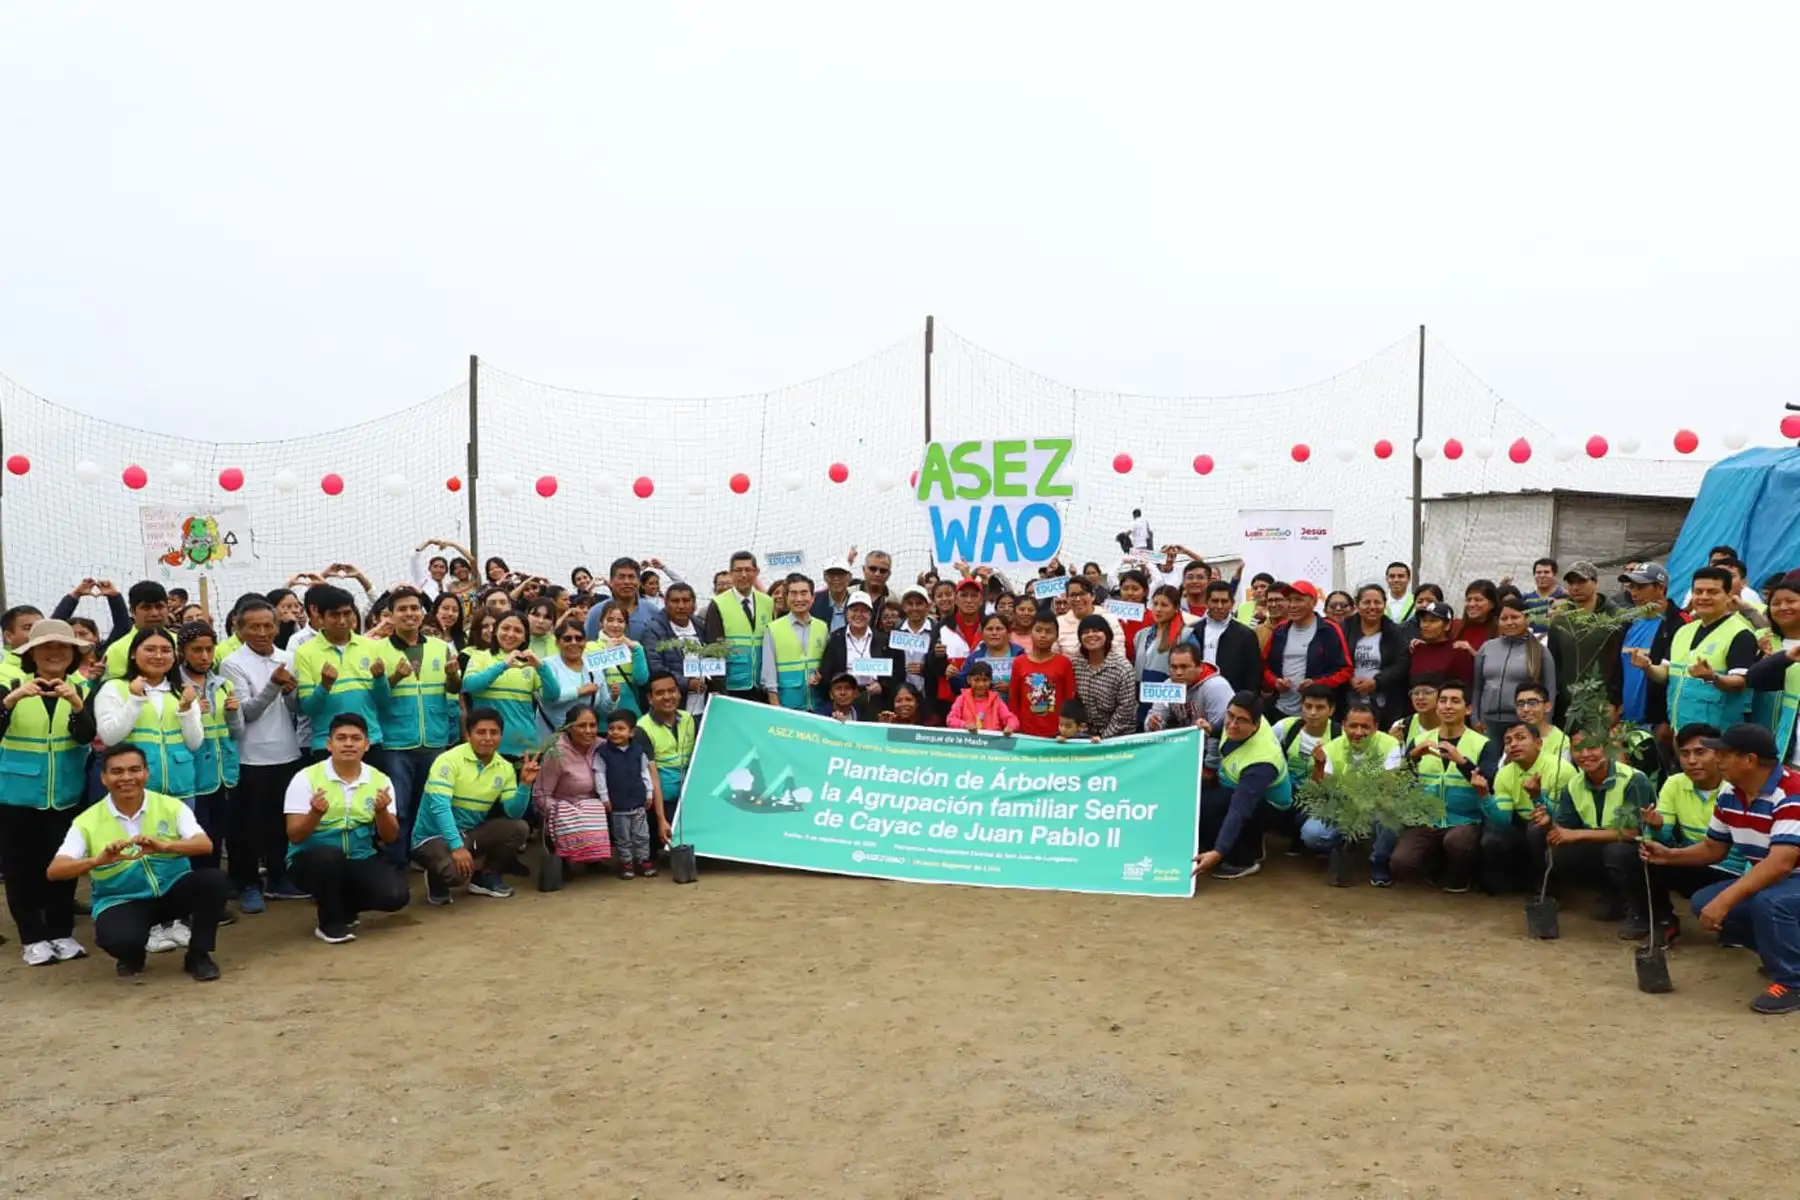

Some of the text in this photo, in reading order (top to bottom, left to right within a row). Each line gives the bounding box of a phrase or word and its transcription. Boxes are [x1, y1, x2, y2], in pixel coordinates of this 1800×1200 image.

[917, 439, 1074, 501] ASEZ
[929, 503, 1062, 563] WAO
[1036, 580, 1066, 595] EDUCC
[588, 651, 625, 667] EDUCCA
[892, 634, 925, 648] EDUCCA
[1143, 687, 1181, 698] EDUCCA
[828, 756, 1117, 792] Plantación de Árboles en
[820, 782, 1159, 820] la Agrupación familiar Señor
[814, 808, 1121, 848] de Cayac de Juan Pablo II
